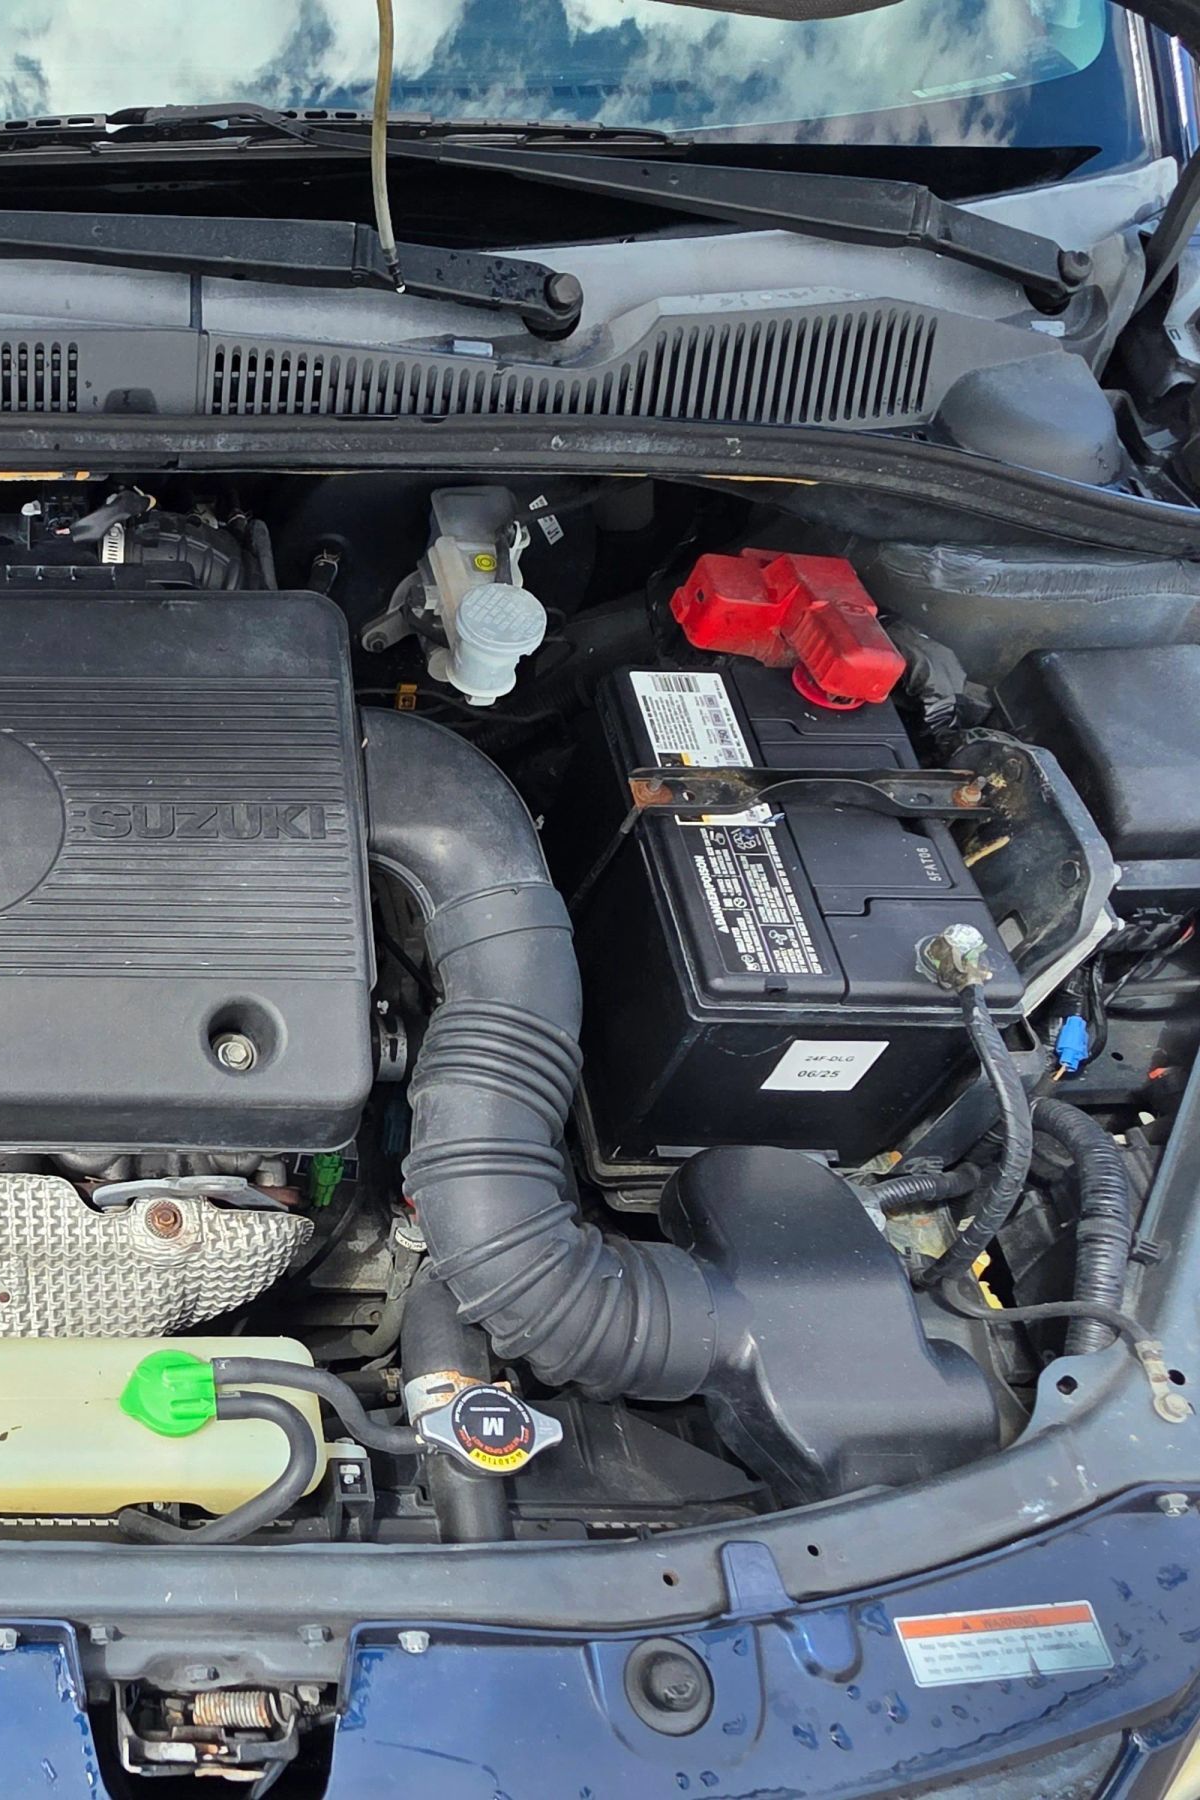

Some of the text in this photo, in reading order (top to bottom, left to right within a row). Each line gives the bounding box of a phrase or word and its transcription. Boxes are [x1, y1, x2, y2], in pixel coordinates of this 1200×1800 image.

[87, 803, 328, 841] SUZUKI
[916, 847, 942, 882] 5FAT06
[804, 1055, 855, 1063] 24F-DLG
[796, 1069, 841, 1078] 06/25
[482, 1416, 504, 1437] M
[473, 1451, 518, 1466] CAUTION
[981, 1613, 1040, 1630] WARNING
